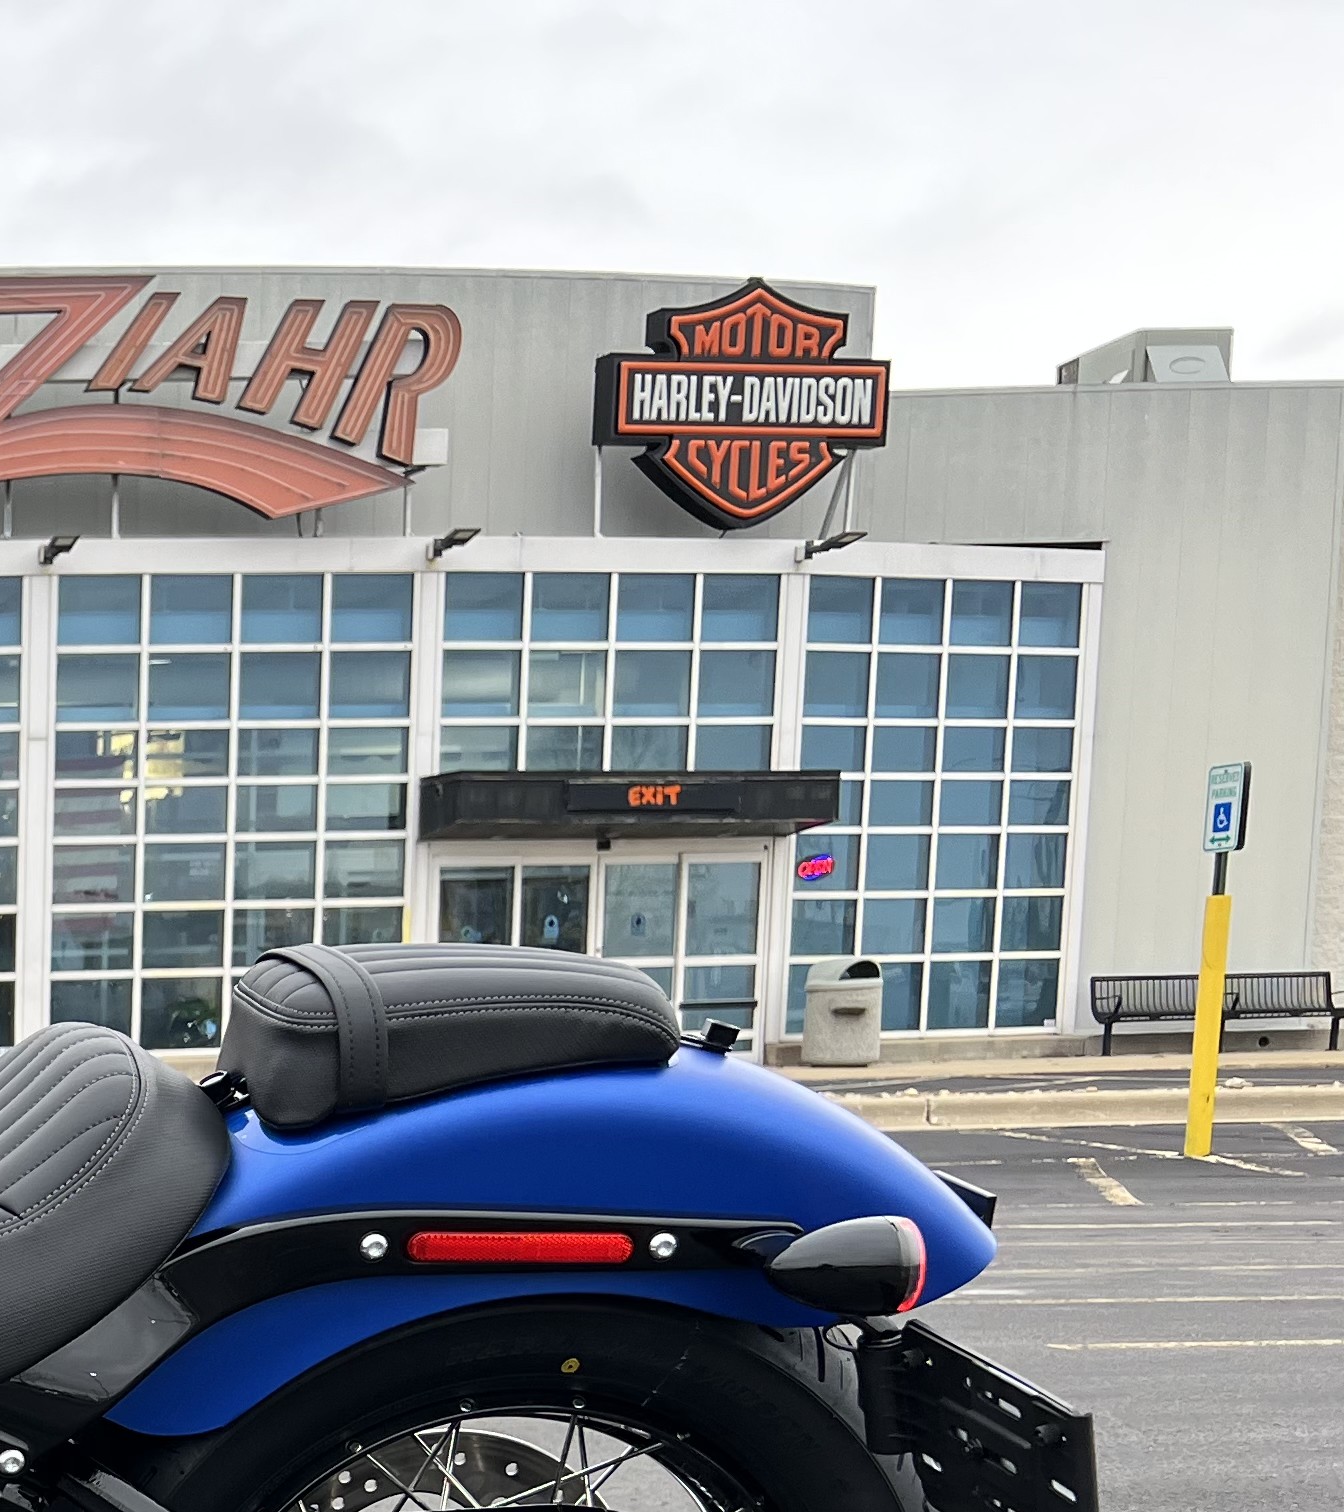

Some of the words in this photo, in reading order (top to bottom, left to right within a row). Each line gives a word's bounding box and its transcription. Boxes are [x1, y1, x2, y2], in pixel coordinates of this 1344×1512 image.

[693, 302, 820, 359] MOTOR
[631, 373, 873, 425] HARLEY-DAVIDSON
[687, 439, 811, 501] CYCLES
[627, 784, 682, 807] EXIT
